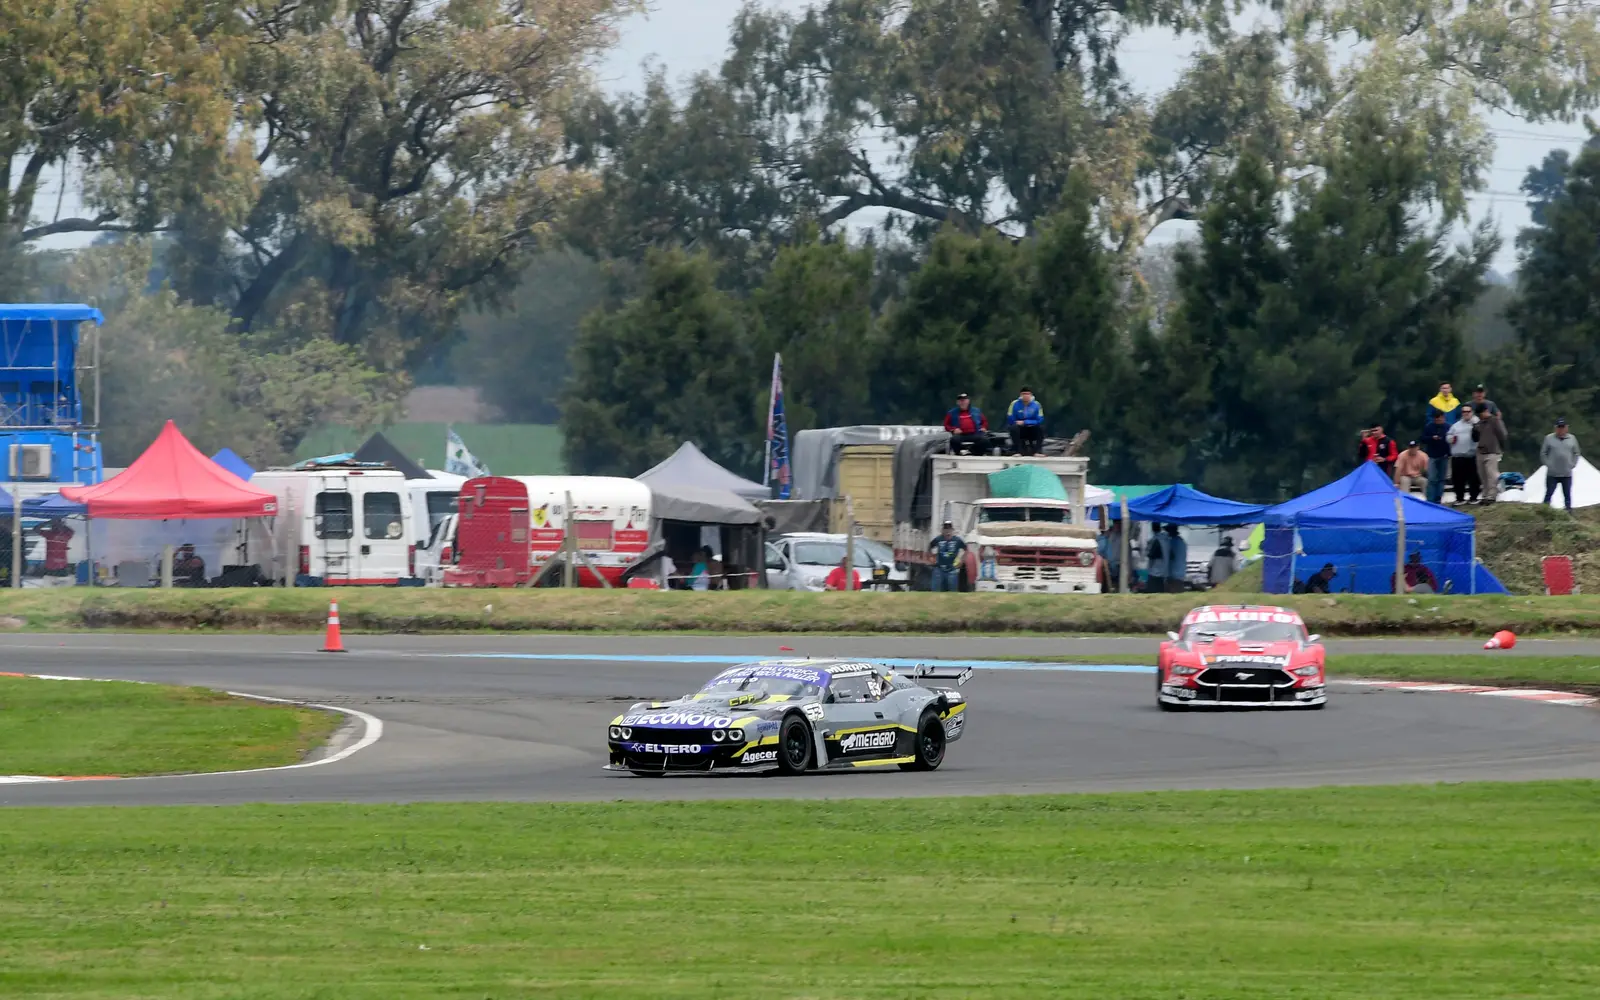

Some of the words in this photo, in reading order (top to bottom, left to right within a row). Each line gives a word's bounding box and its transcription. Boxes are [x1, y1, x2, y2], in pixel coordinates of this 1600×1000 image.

[824, 662, 873, 674] MURRAY
[867, 681, 881, 697] 53
[803, 702, 824, 720] 53
[637, 713, 733, 728] ECONOVO
[742, 750, 777, 763] Agecer
